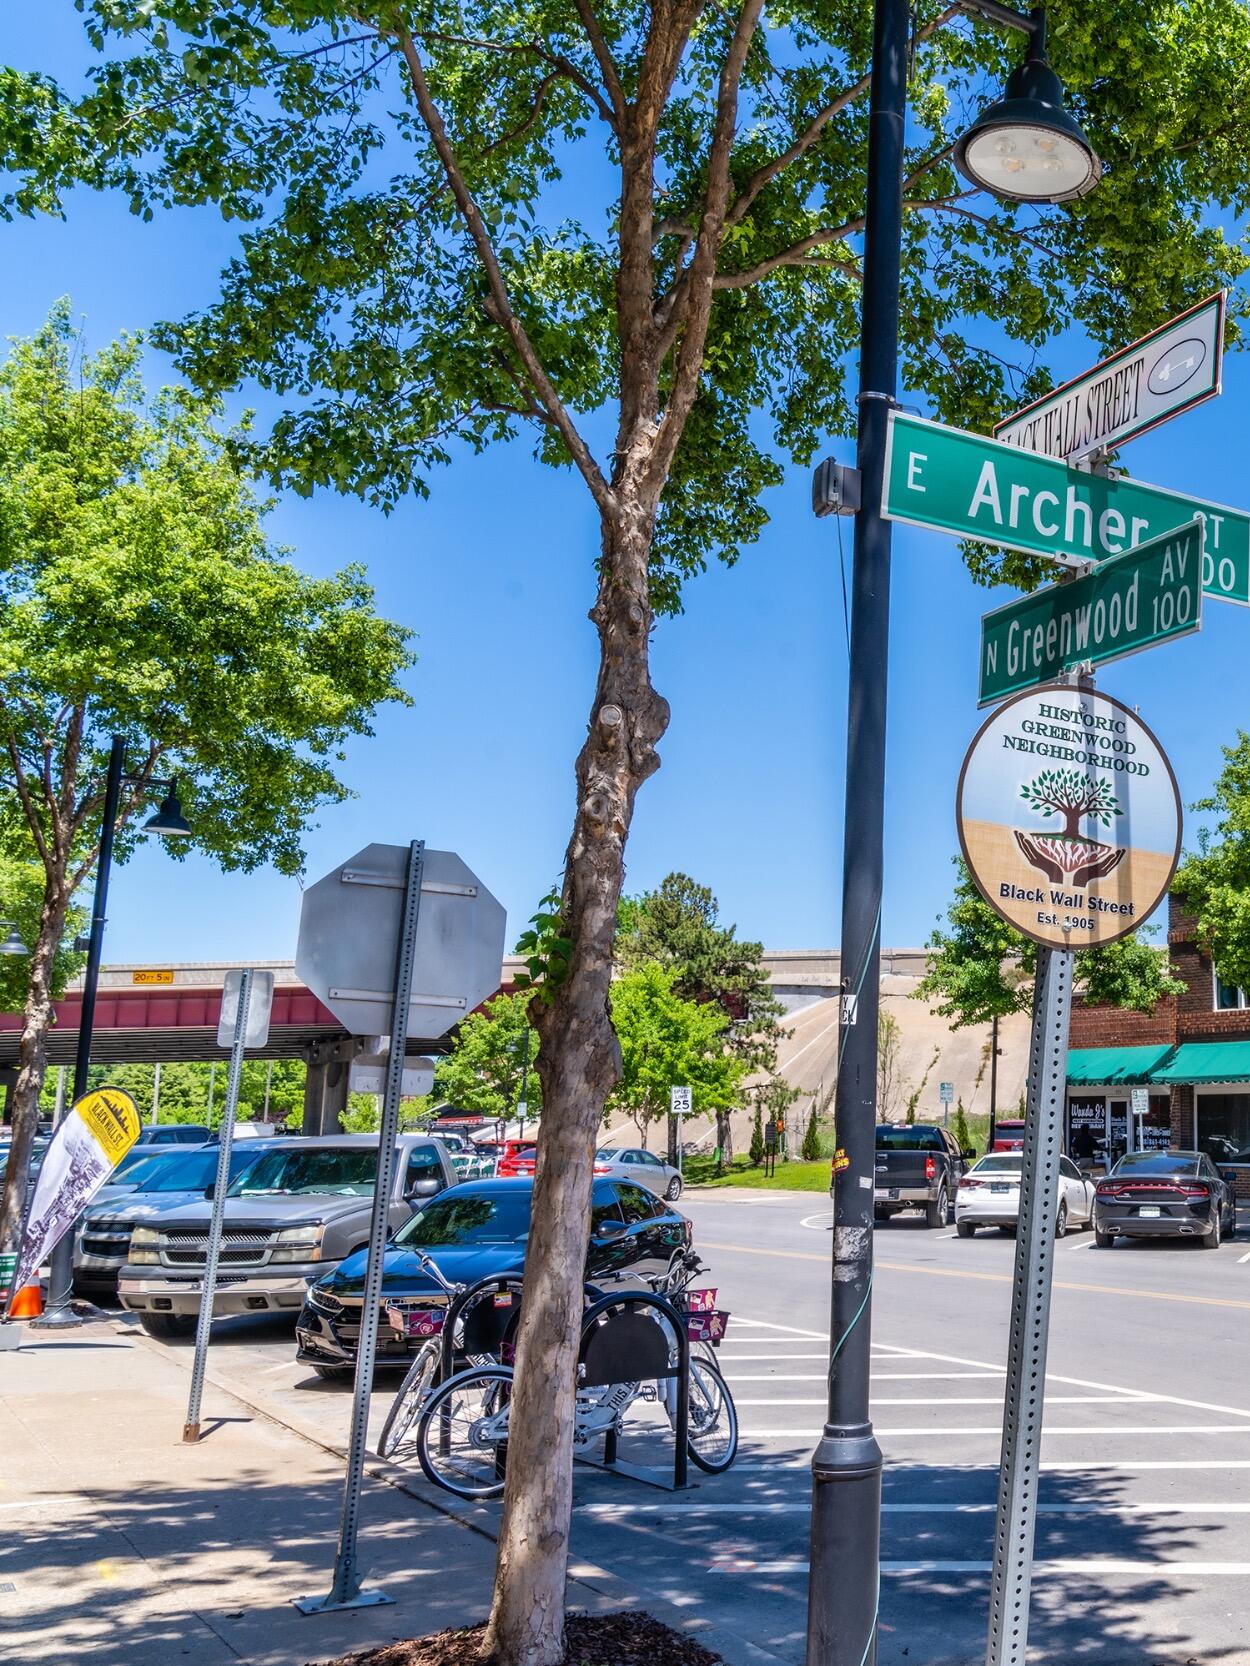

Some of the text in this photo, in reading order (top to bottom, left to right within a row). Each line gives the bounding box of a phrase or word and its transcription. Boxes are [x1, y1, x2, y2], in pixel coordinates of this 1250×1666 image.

[1044, 395, 1081, 458] WALL
[1084, 358, 1145, 445] STREET
[907, 451, 928, 492] E
[967, 461, 1150, 554] Archer
[1160, 537, 1191, 587] AV
[1201, 552, 1236, 592] 00
[986, 570, 1192, 677] N Greenwood 100
[1038, 703, 1127, 734] HISTORIC
[1021, 719, 1137, 755] GREENWOOD
[1002, 735, 1151, 777] NEIGHBORHOOD
[999, 882, 1136, 916] Black Wall Street
[1037, 911, 1095, 930] Est. 1905
[134, 973, 146, 982] 20
[156, 973, 163, 981] 5
[91, 1102, 109, 1125] BLACK
[104, 1119, 118, 1140] WALL
[673, 1100, 690, 1110] 25
[1071, 1103, 1094, 1118] Wanda
[606, 1388, 628, 1411] THIS
